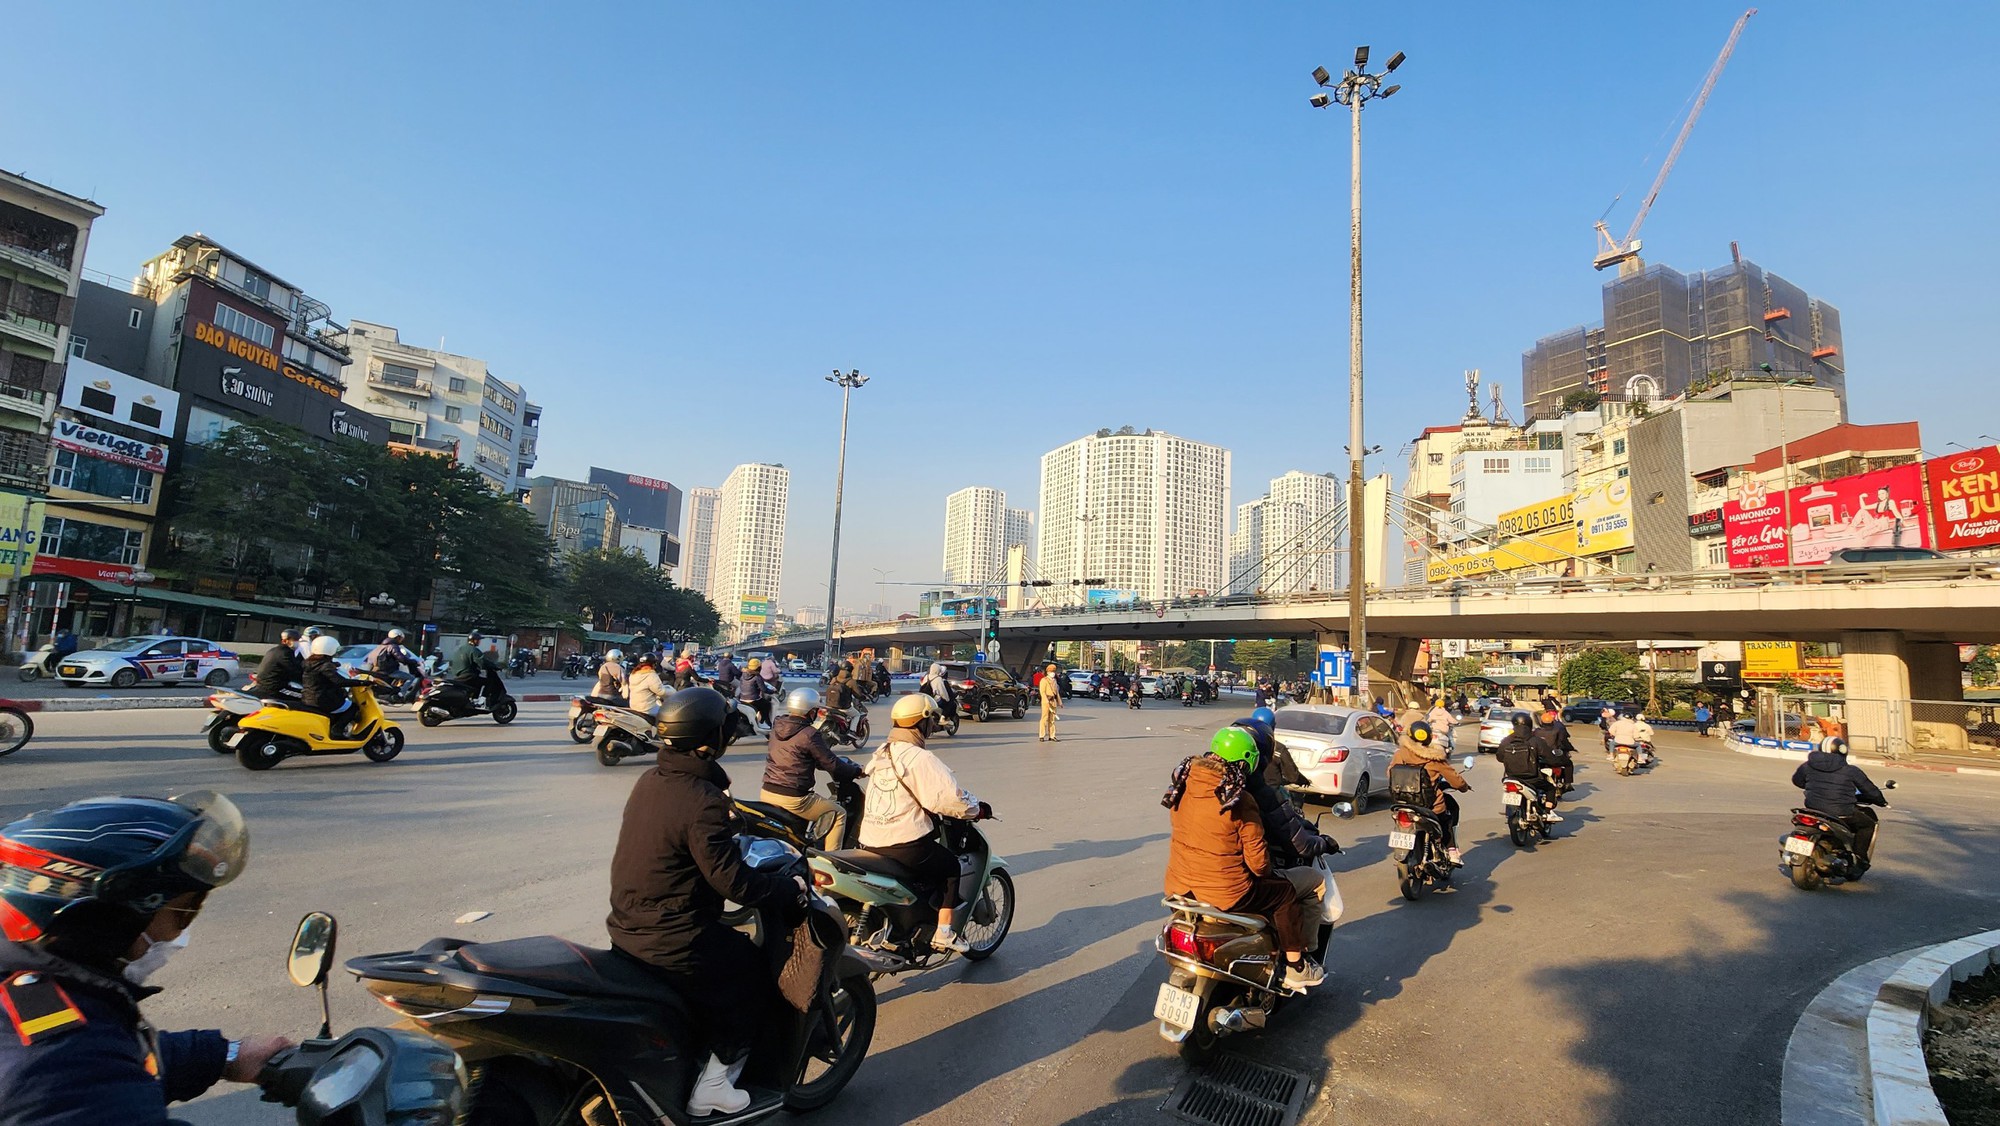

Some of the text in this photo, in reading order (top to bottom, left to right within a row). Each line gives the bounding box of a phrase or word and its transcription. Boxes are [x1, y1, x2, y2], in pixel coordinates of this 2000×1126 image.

[195, 321, 224, 348] ĐÀO
[230, 378, 243, 396] 30
[282, 366, 339, 398] Coffee
[337, 420, 348, 435] 30
[60, 421, 144, 456] Vietlott
[1941, 471, 1999, 498] KEN
[1500, 515, 1523, 535] 0982
[1526, 510, 1539, 529] 05
[1542, 506, 1556, 526] 05
[1560, 502, 1574, 521] 05
[1614, 518, 1628, 529] 5555
[1729, 506, 1781, 523] HAWONKOO
[557, 523, 580, 538] Spa
[1750, 542, 1785, 553] HAWONKOO
[1467, 559, 1480, 571] 05
[1746, 642, 1773, 650] TRANG
[1164, 988, 1193, 1010] 30-M3
[1160, 1003, 1188, 1025] 9090
